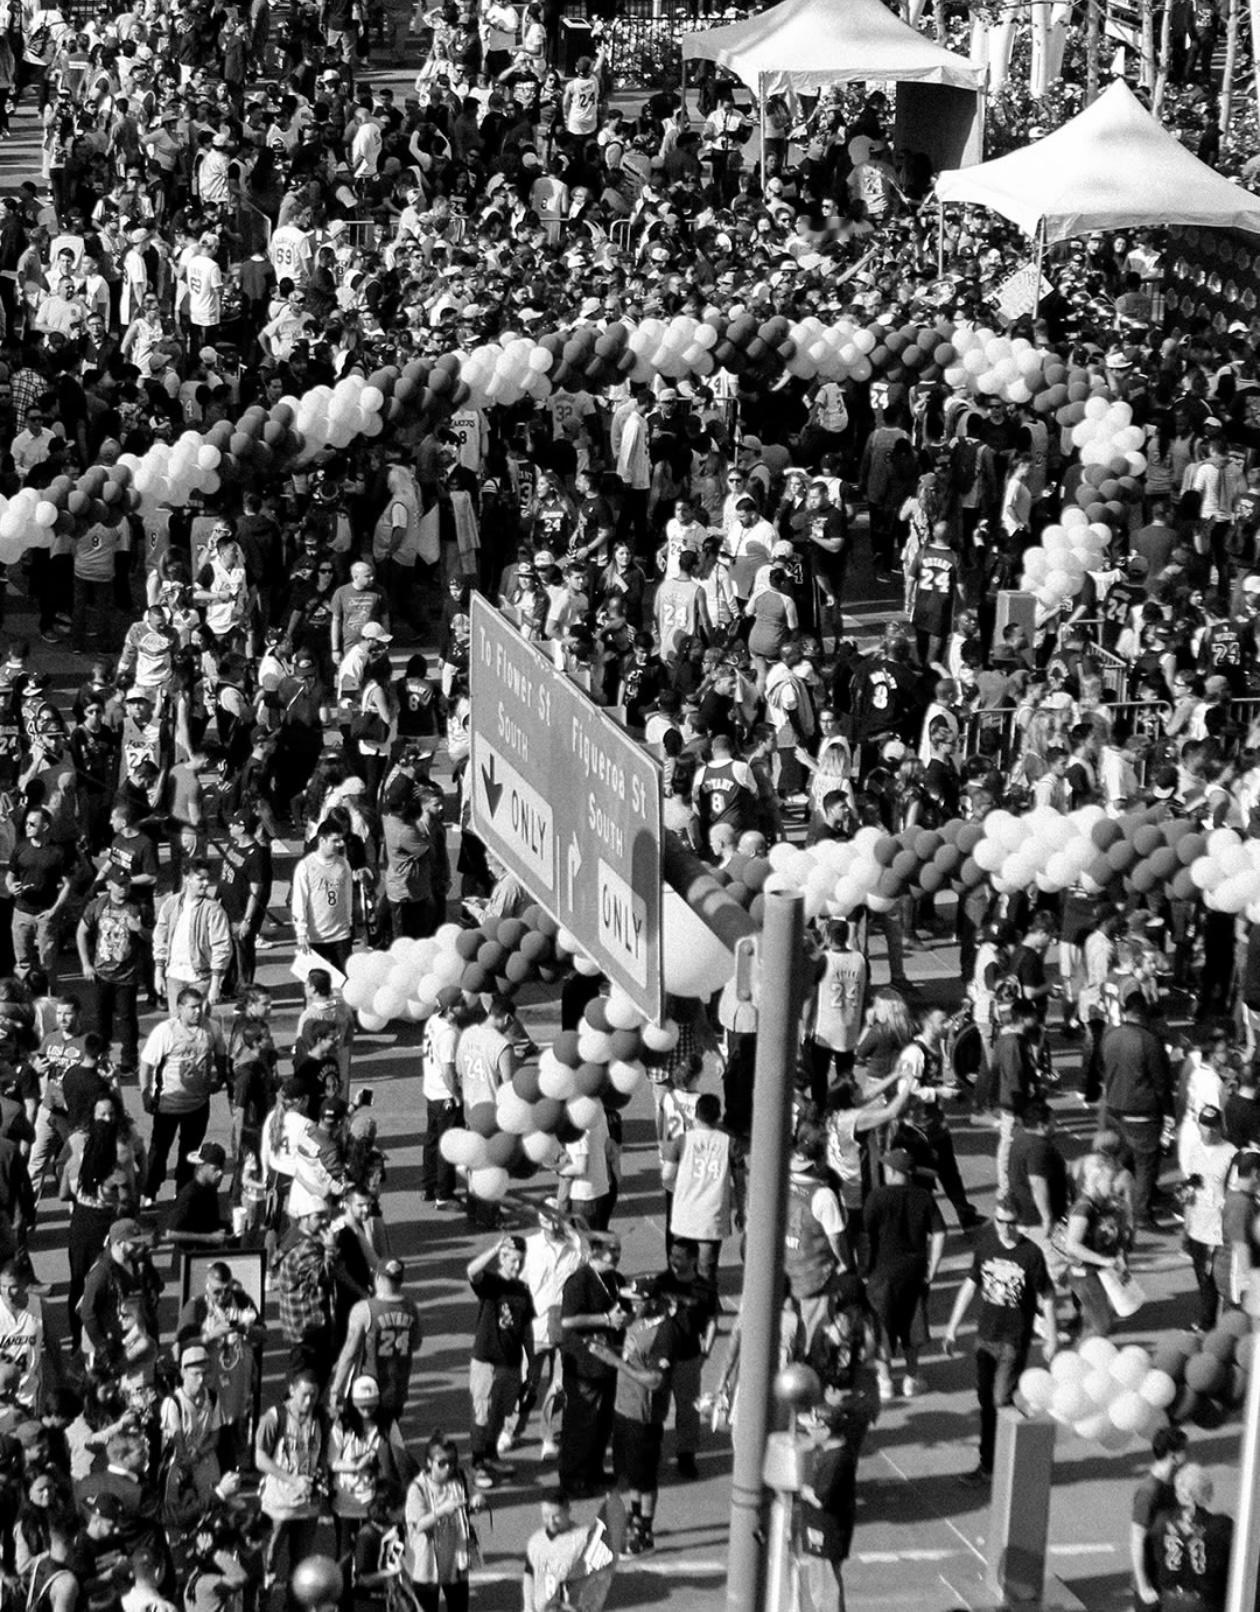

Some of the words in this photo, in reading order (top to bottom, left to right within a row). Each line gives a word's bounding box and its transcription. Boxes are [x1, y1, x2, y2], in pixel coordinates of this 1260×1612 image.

[544, 519, 561, 532] 24
[918, 568, 950, 593] 24
[663, 603, 688, 628] 24
[1107, 597, 1128, 625] 24
[479, 625, 493, 666] To
[496, 653, 533, 709] Flower
[538, 684, 551, 727] St
[571, 715, 626, 800] Figueroa
[632, 774, 648, 820] St
[511, 788, 547, 862] ONLY
[327, 890, 337, 906] 8
[602, 882, 644, 960] ONLY
[464, 1055, 487, 1082] 24
[693, 1157, 721, 1180] 34
[377, 1329, 411, 1356] 24
